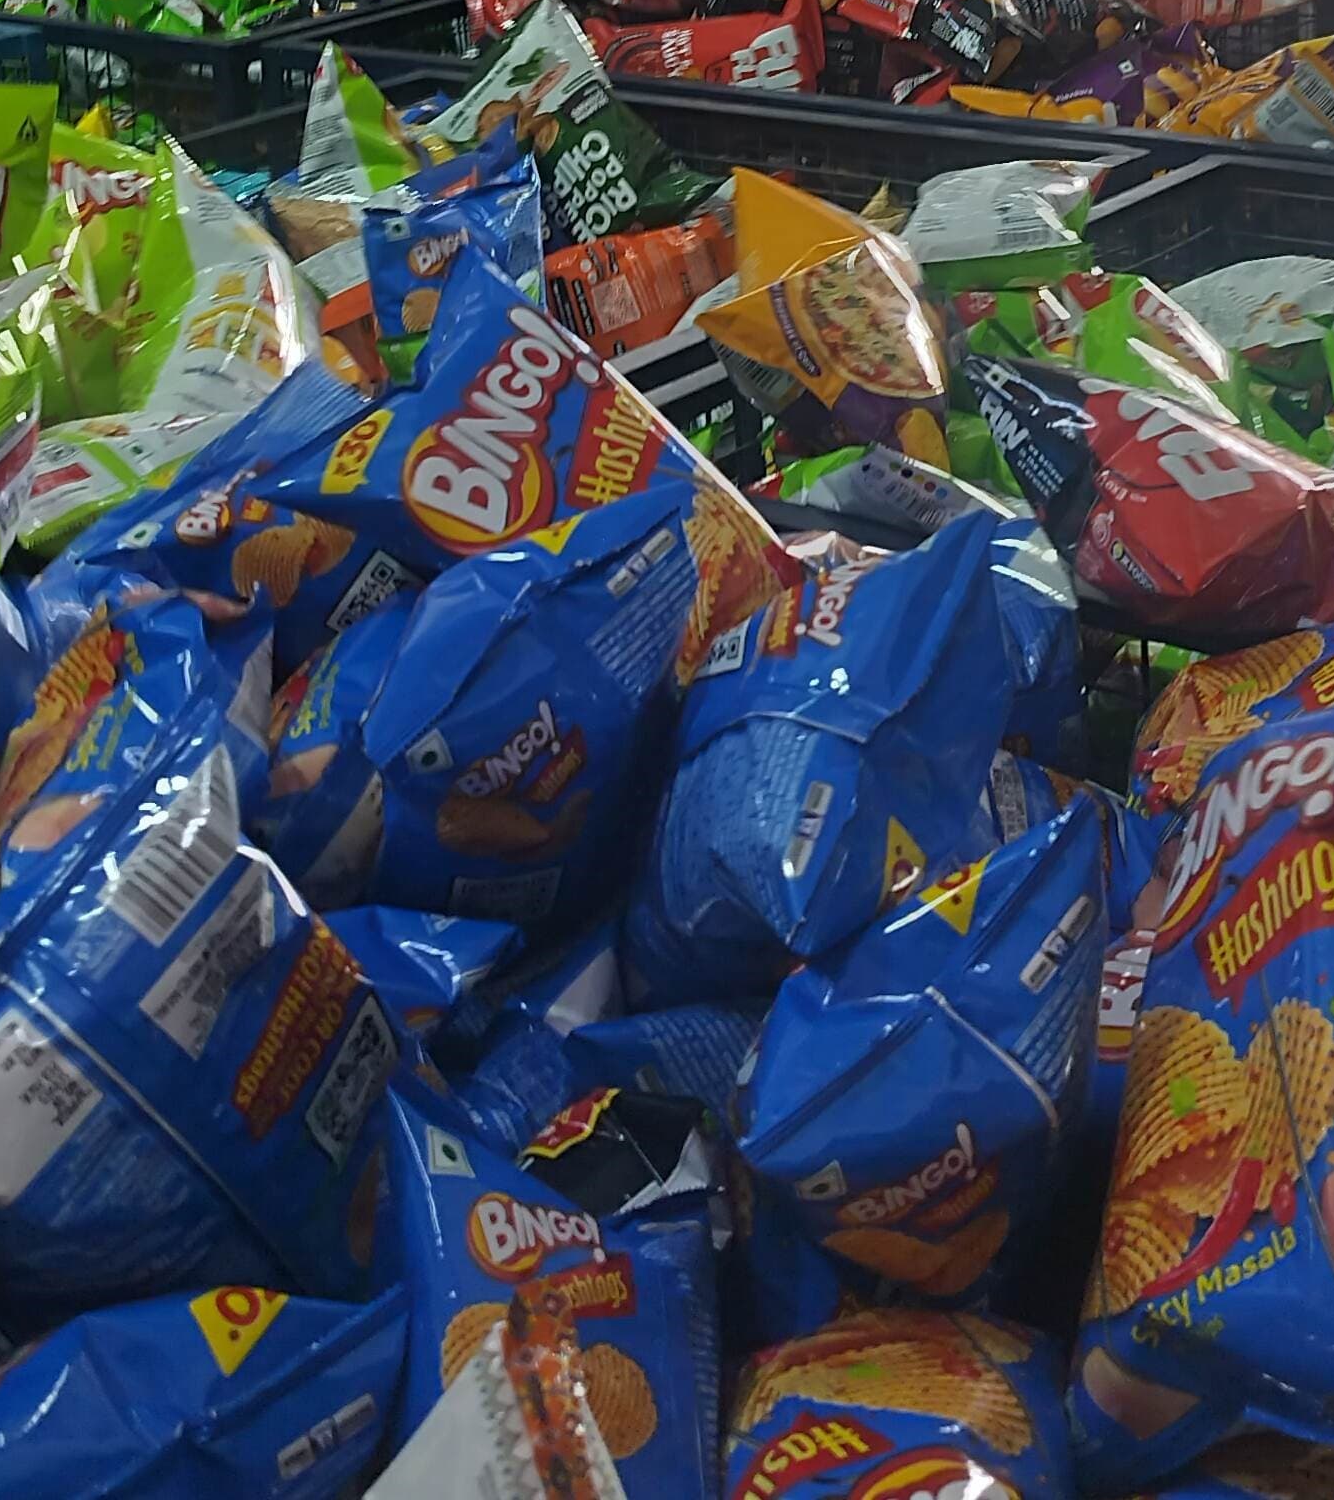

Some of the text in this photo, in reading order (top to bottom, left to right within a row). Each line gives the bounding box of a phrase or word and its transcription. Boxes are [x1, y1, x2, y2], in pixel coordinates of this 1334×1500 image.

[410, 306, 603, 534] BINGO!
[459, 700, 558, 796] BINGO!
[851, 1121, 977, 1225] BINGO!
[478, 1194, 607, 1265] BINGO!
[1195, 1226, 1297, 1306] Masala
